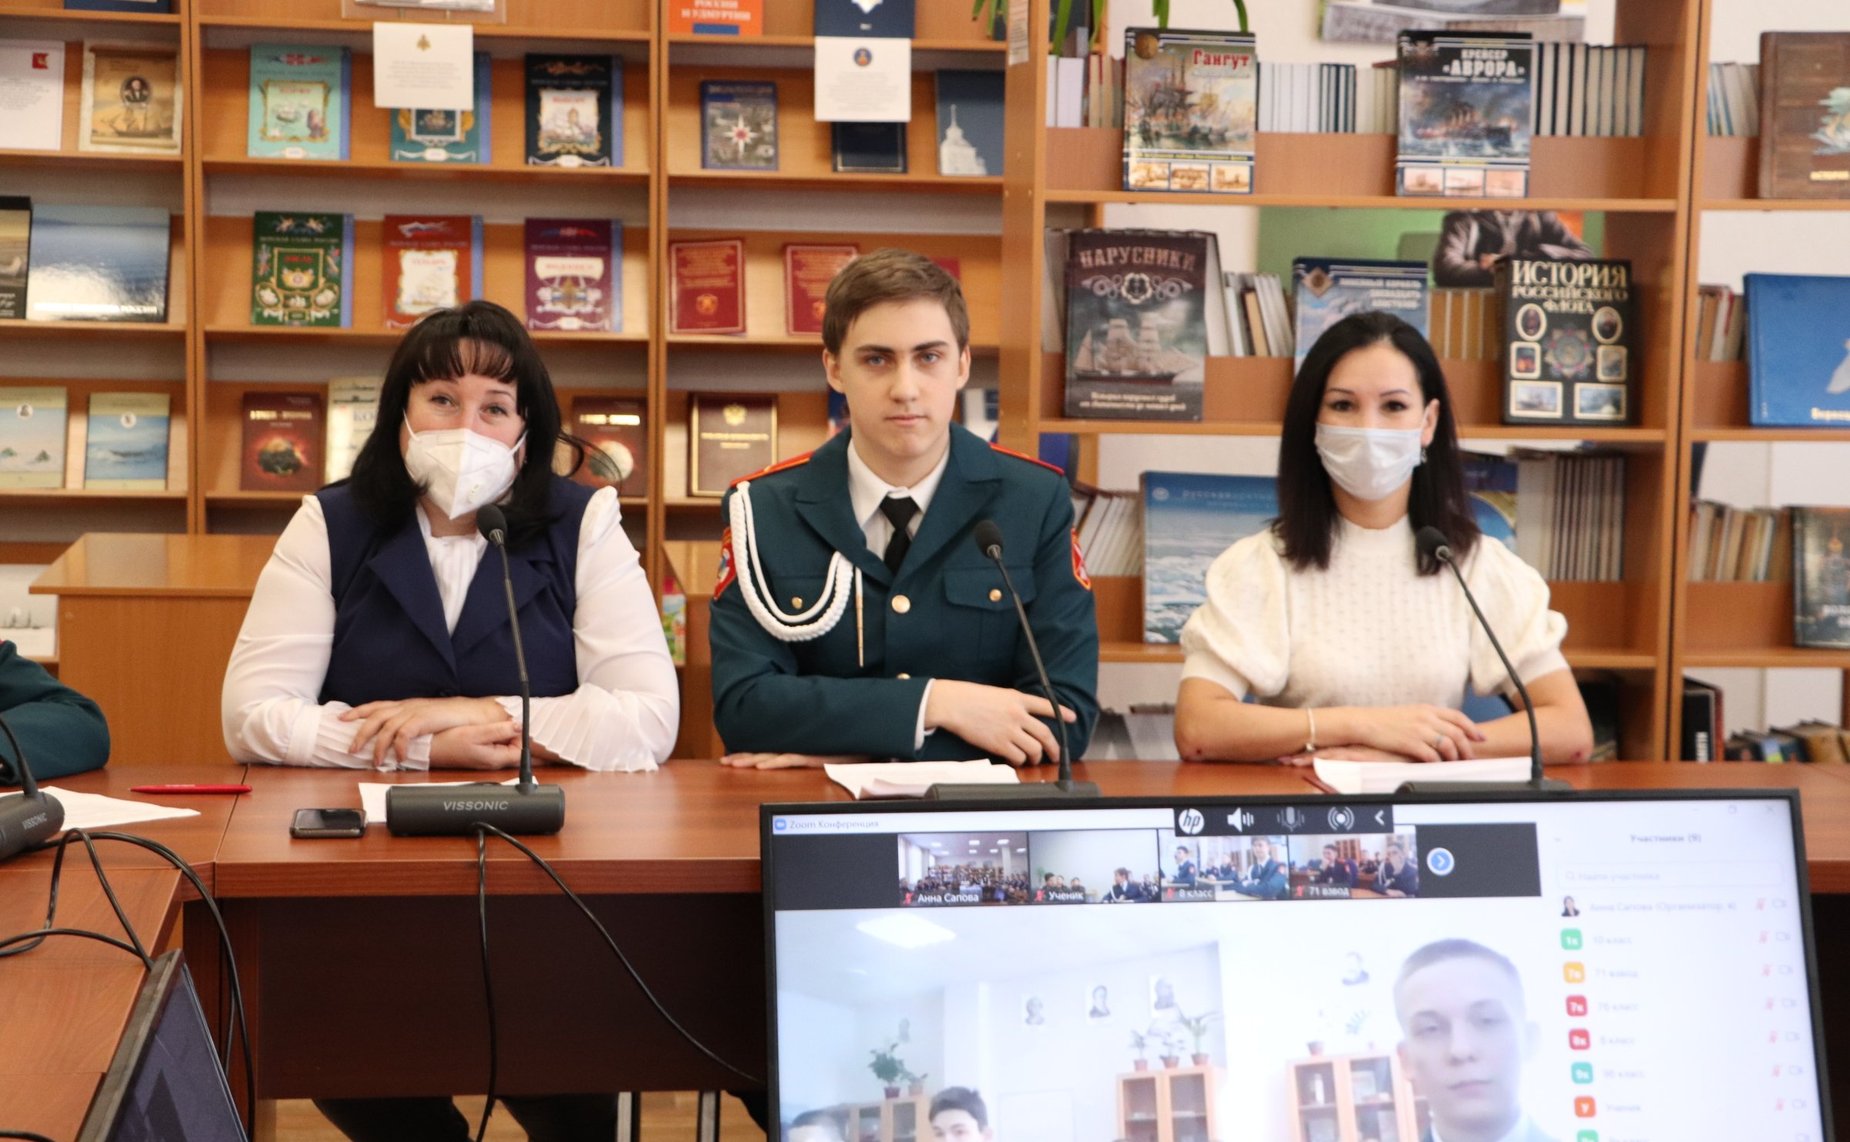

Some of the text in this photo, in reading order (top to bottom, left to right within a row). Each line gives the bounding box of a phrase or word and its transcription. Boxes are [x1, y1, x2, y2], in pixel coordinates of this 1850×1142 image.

[1192, 48, 1249, 70] Гангут
[1511, 260, 1627, 288] ИСТОРИЯ
[1511, 285, 1629, 302] РОССИЙСКОГО
[1542, 299, 1595, 314] ФЛОТА
[443, 800, 509, 811] VISSONIC
[790, 820, 880, 830] Zoom Конференция
[1048, 891, 1084, 901] Ученик
[1187, 889, 1213, 898] класс
[1309, 886, 1320, 896] 71
[917, 892, 979, 903] Анна Сапова
